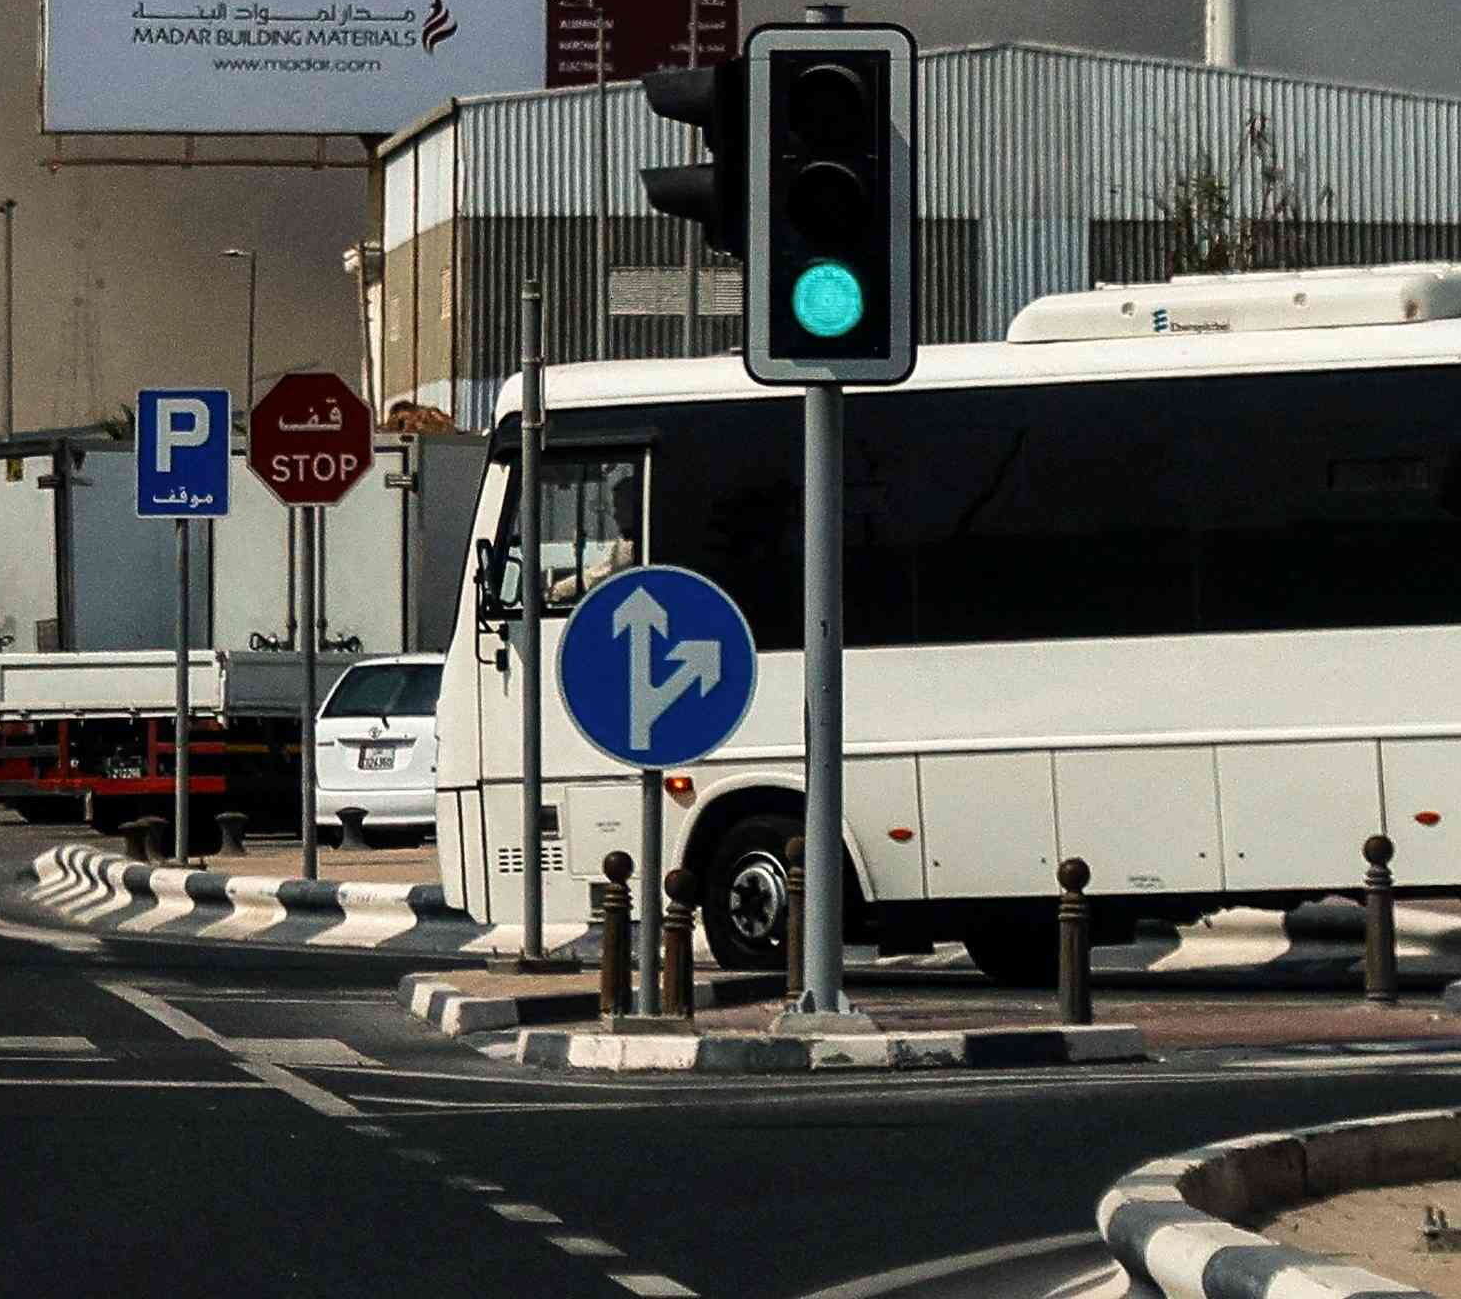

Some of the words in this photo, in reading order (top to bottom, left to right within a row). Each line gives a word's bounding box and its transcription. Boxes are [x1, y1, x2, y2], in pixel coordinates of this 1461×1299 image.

[133, 26, 211, 46] MADAR
[216, 27, 303, 46] BUILDING
[308, 28, 417, 46] MATERIALS
[213, 58, 381, 72] www.madar.com
[278, 398, 344, 432] قف
[155, 398, 210, 473] P
[271, 453, 358, 483] STOP
[151, 485, 214, 508] موقف
